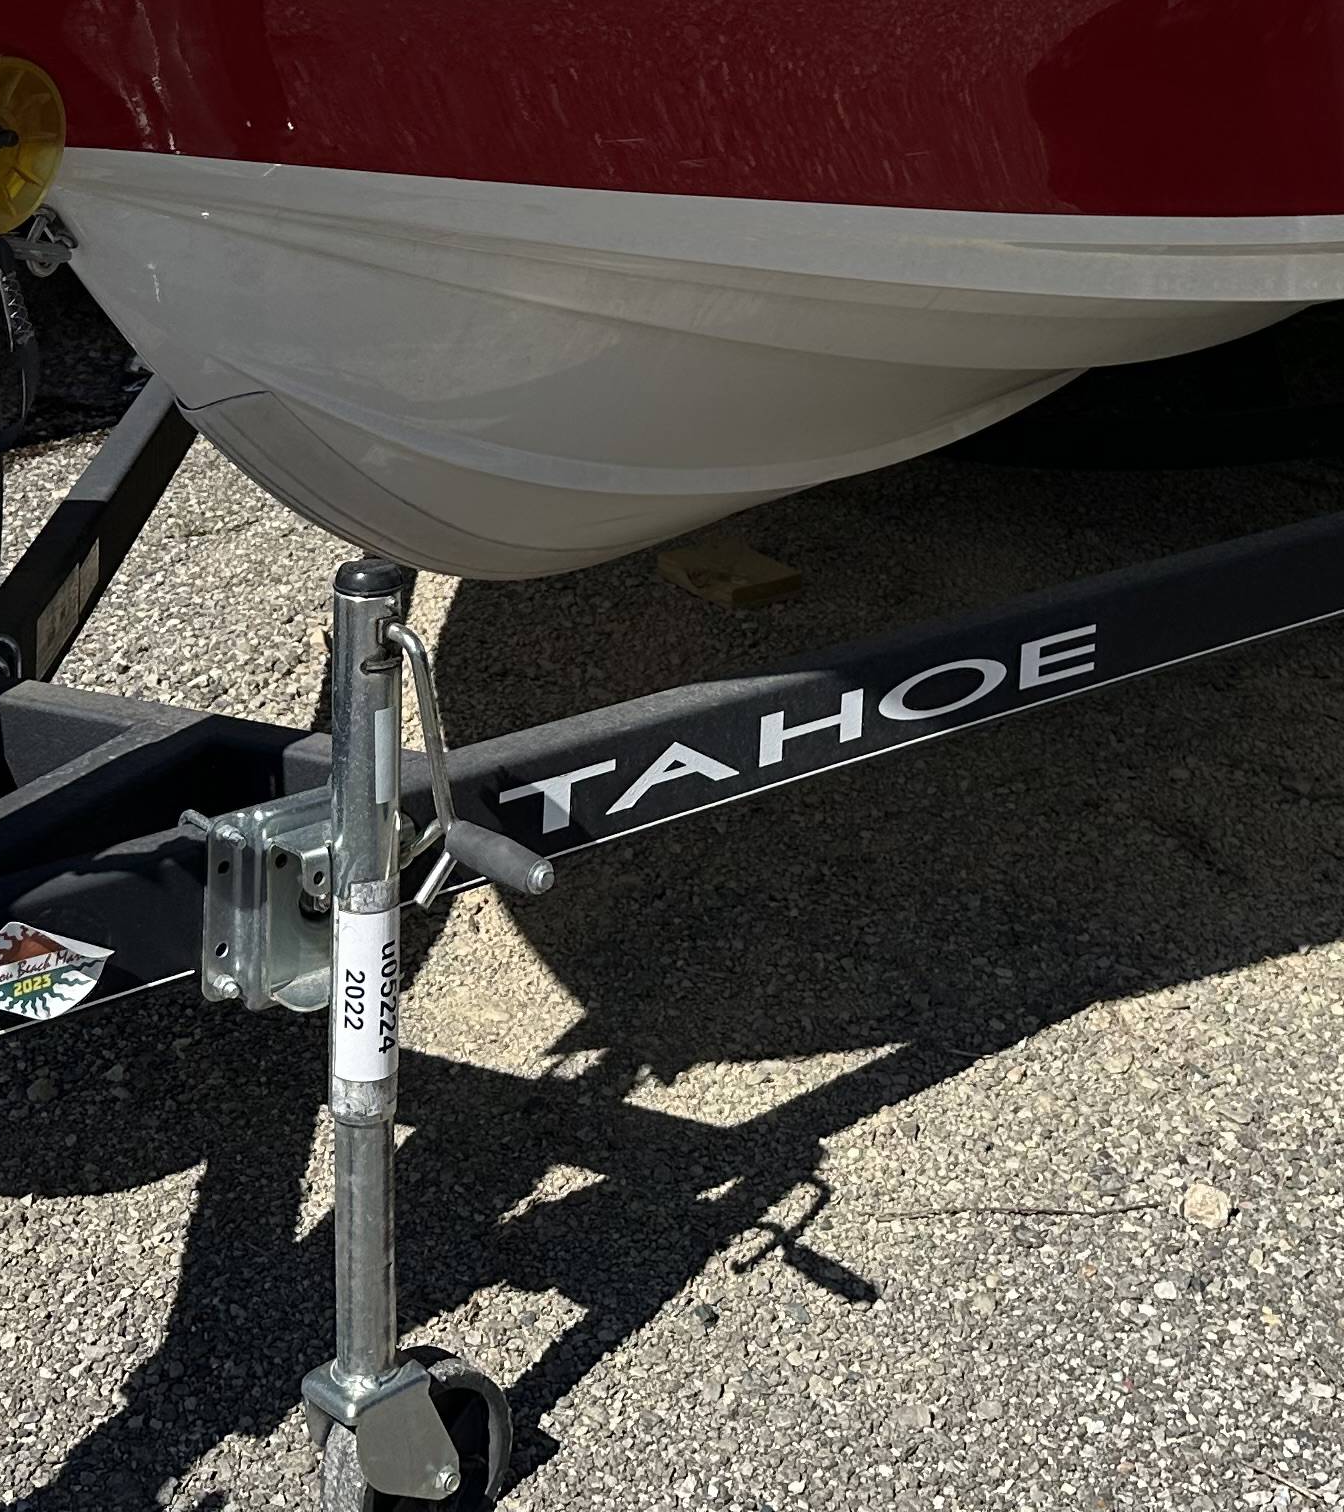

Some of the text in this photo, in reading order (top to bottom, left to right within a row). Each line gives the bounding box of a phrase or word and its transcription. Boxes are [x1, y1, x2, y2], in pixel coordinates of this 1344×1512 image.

[498, 624, 1097, 834] TAHOE
[13, 973, 53, 997] 2023
[17, 953, 52, 979] Beach
[344, 968, 366, 1031] 2022
